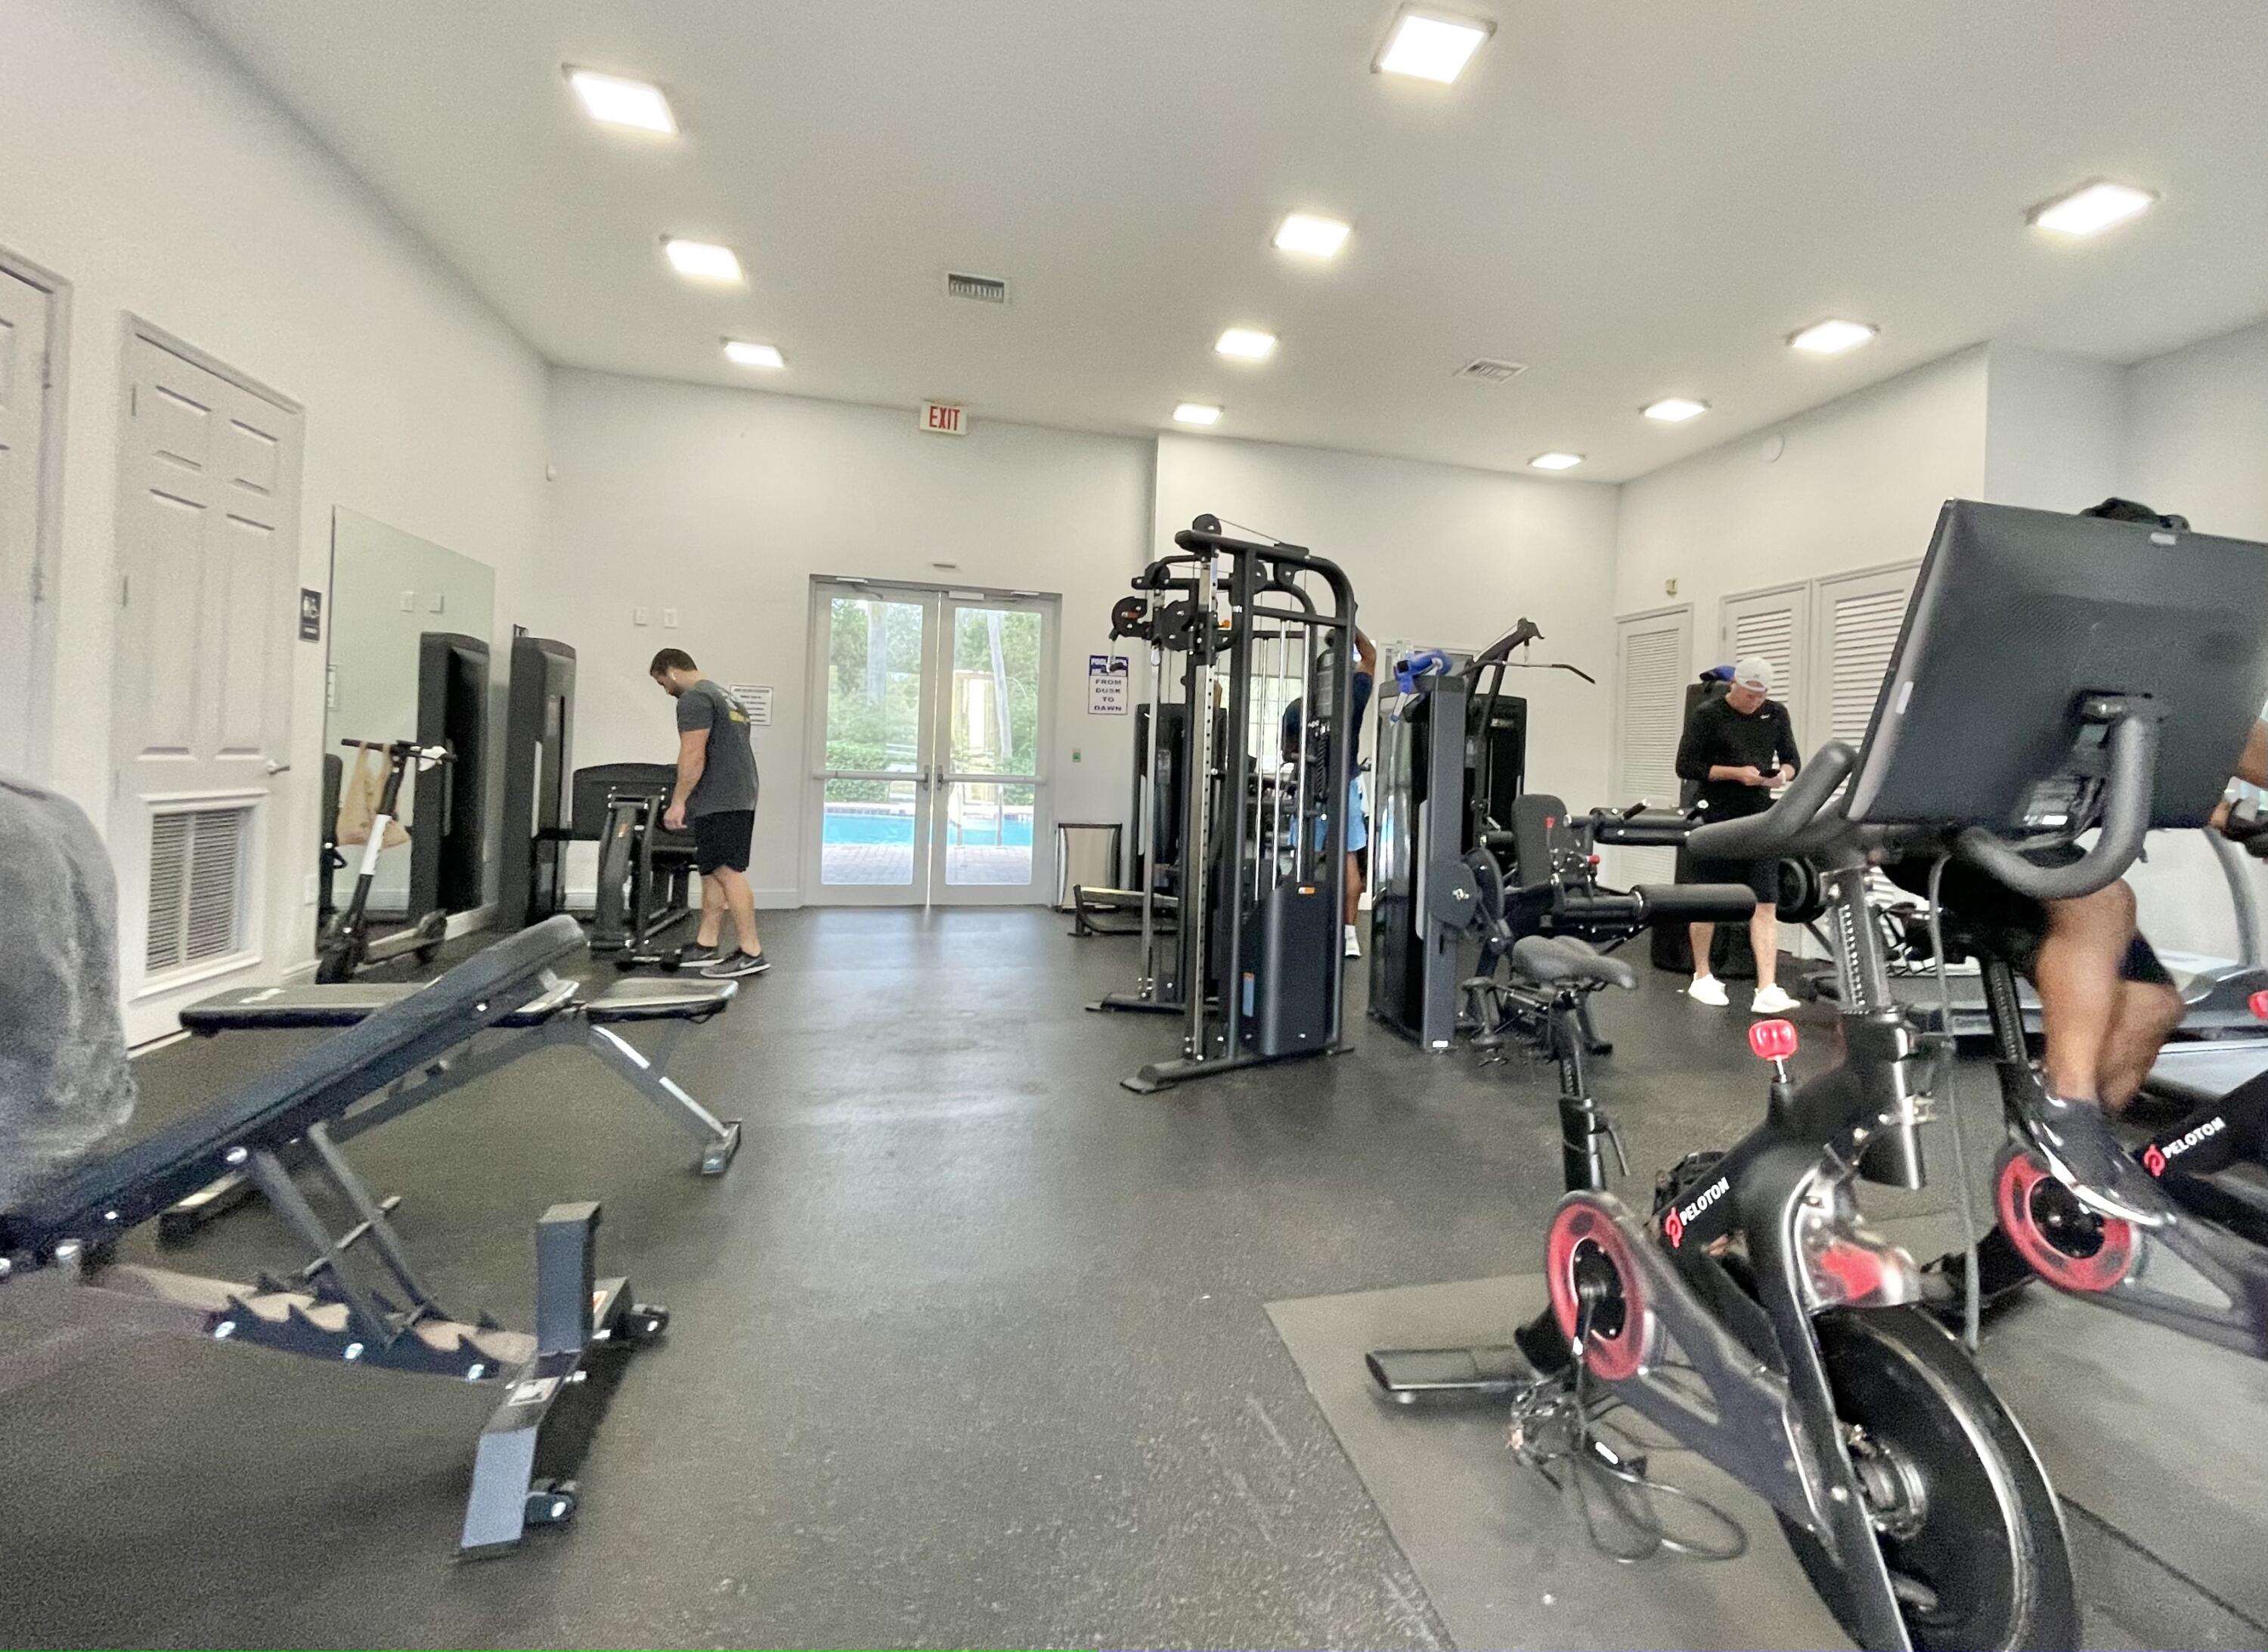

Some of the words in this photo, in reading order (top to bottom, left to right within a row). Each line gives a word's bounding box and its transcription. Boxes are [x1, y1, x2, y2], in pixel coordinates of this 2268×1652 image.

[929, 405, 960, 431] EXIT
[2161, 1116, 2226, 1159] PELOTON
[1679, 1176, 1730, 1226] PELOTON
